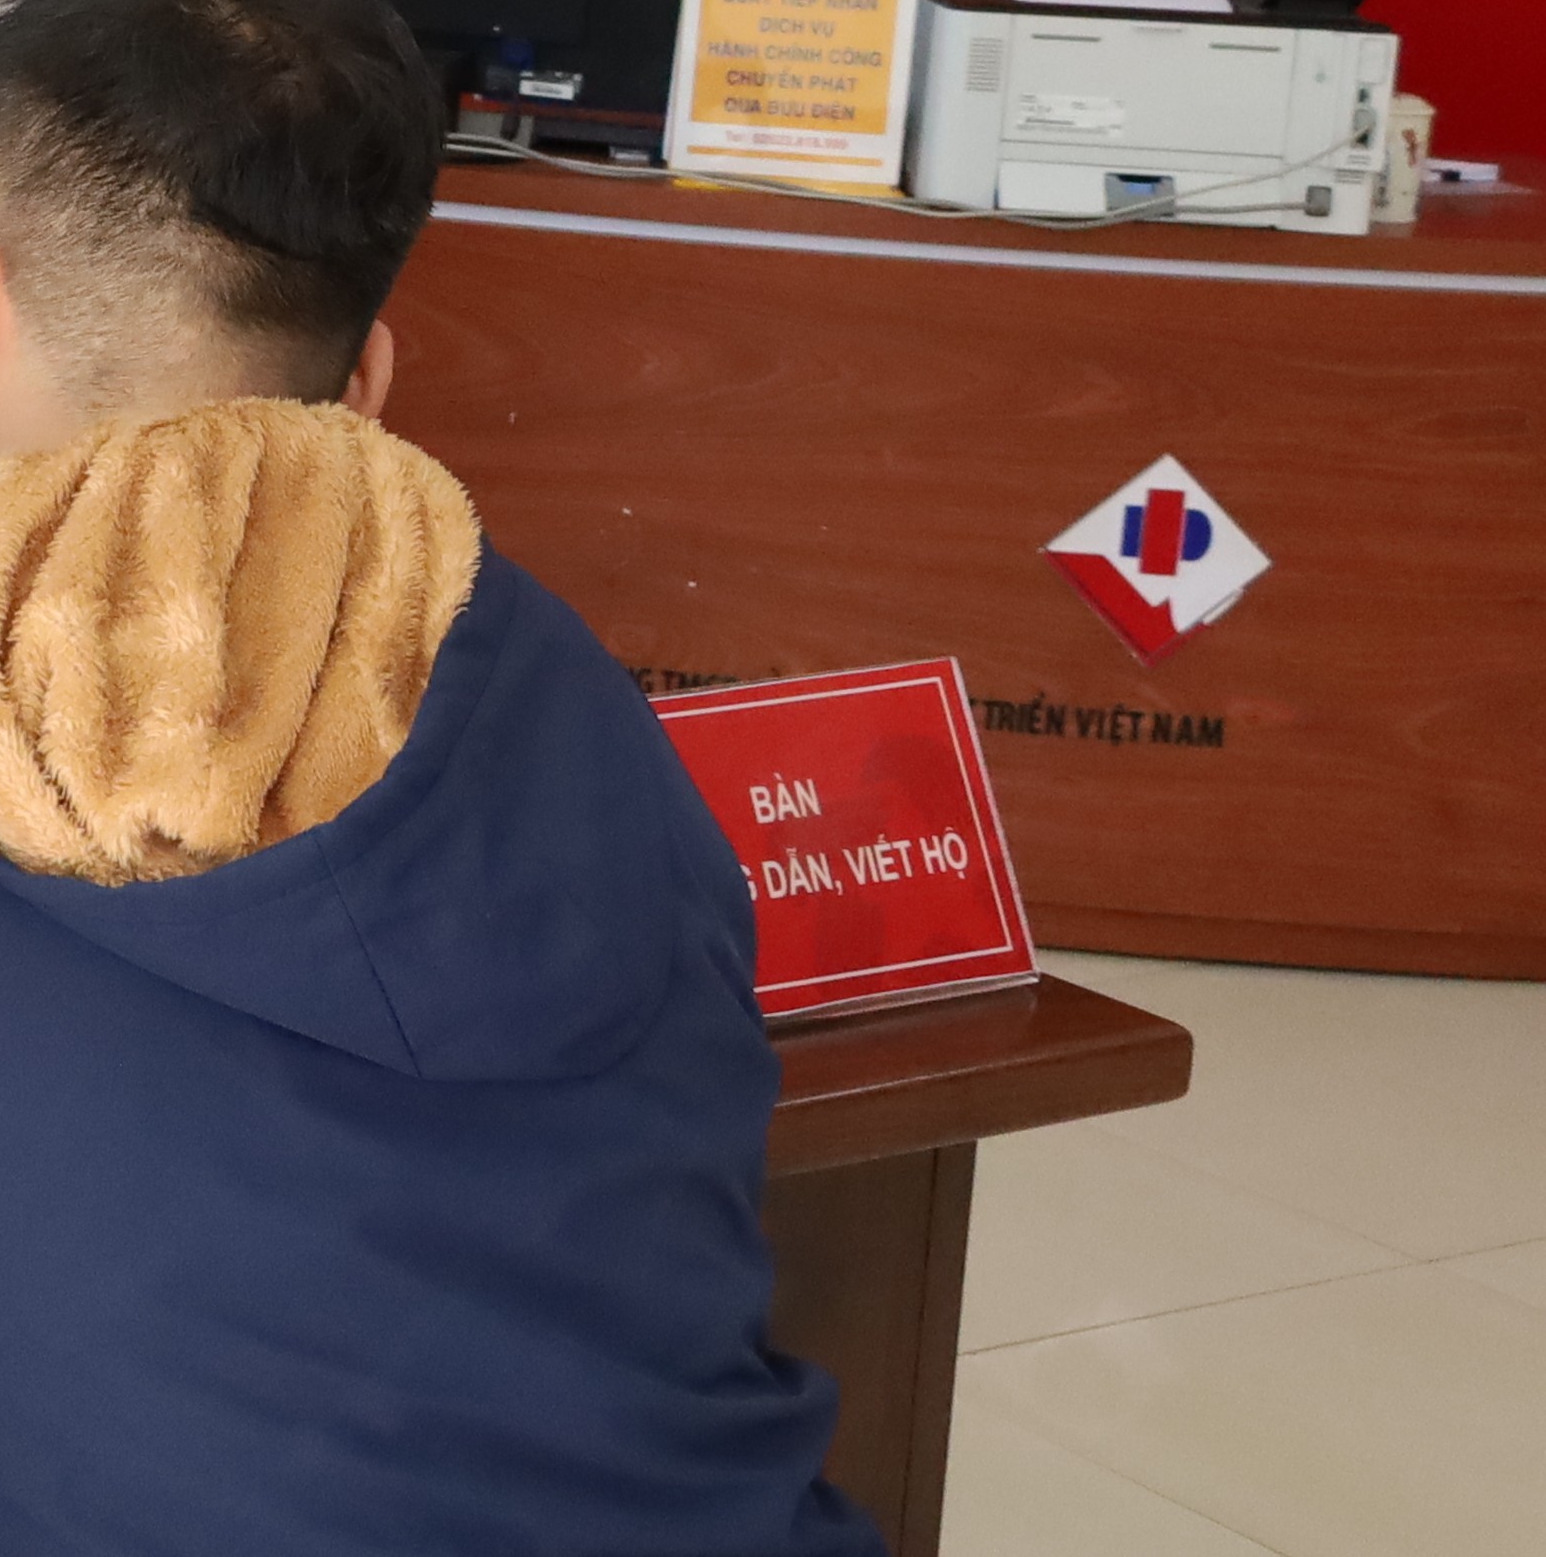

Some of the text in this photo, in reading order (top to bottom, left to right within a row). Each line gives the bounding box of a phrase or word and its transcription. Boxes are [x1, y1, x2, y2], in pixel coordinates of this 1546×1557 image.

[984, 691, 1224, 748] TRIỂN VIỆT NAM
[749, 772, 822, 824] BÀN
[762, 846, 844, 900] DẪN,
[842, 833, 914, 886] VIẾT
[919, 826, 969, 880] HỘ
